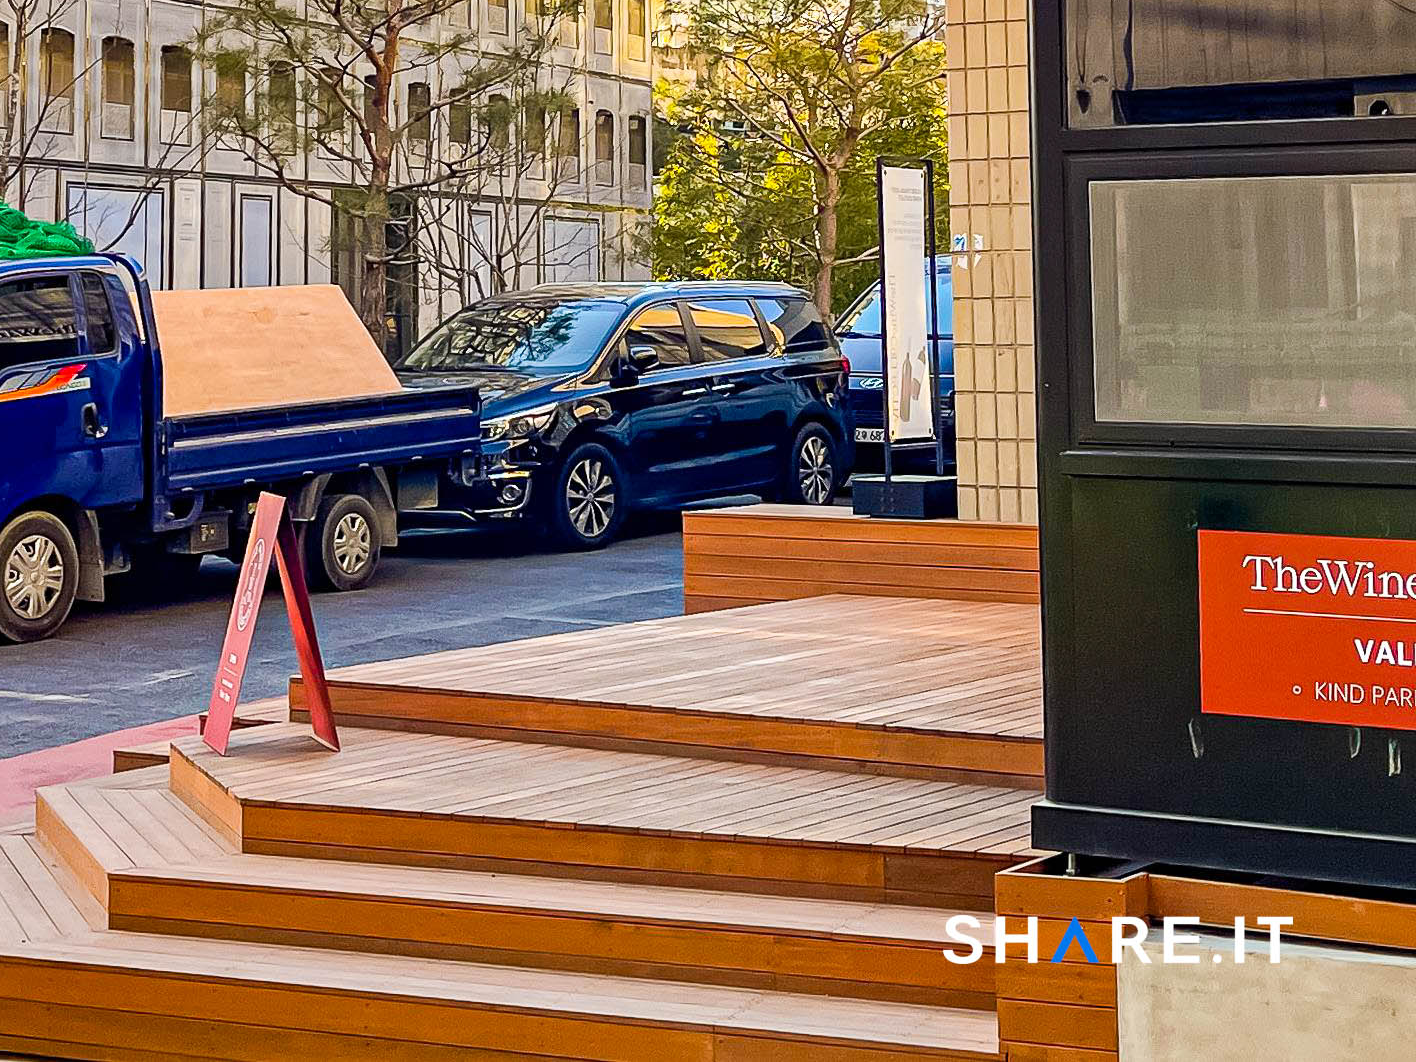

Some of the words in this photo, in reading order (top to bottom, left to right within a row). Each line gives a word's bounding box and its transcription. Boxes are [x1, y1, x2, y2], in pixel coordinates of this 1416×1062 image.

[1353, 638, 1416, 667] VAL
[1314, 681, 1365, 704] KIND
[1372, 685, 1416, 707] PAR
